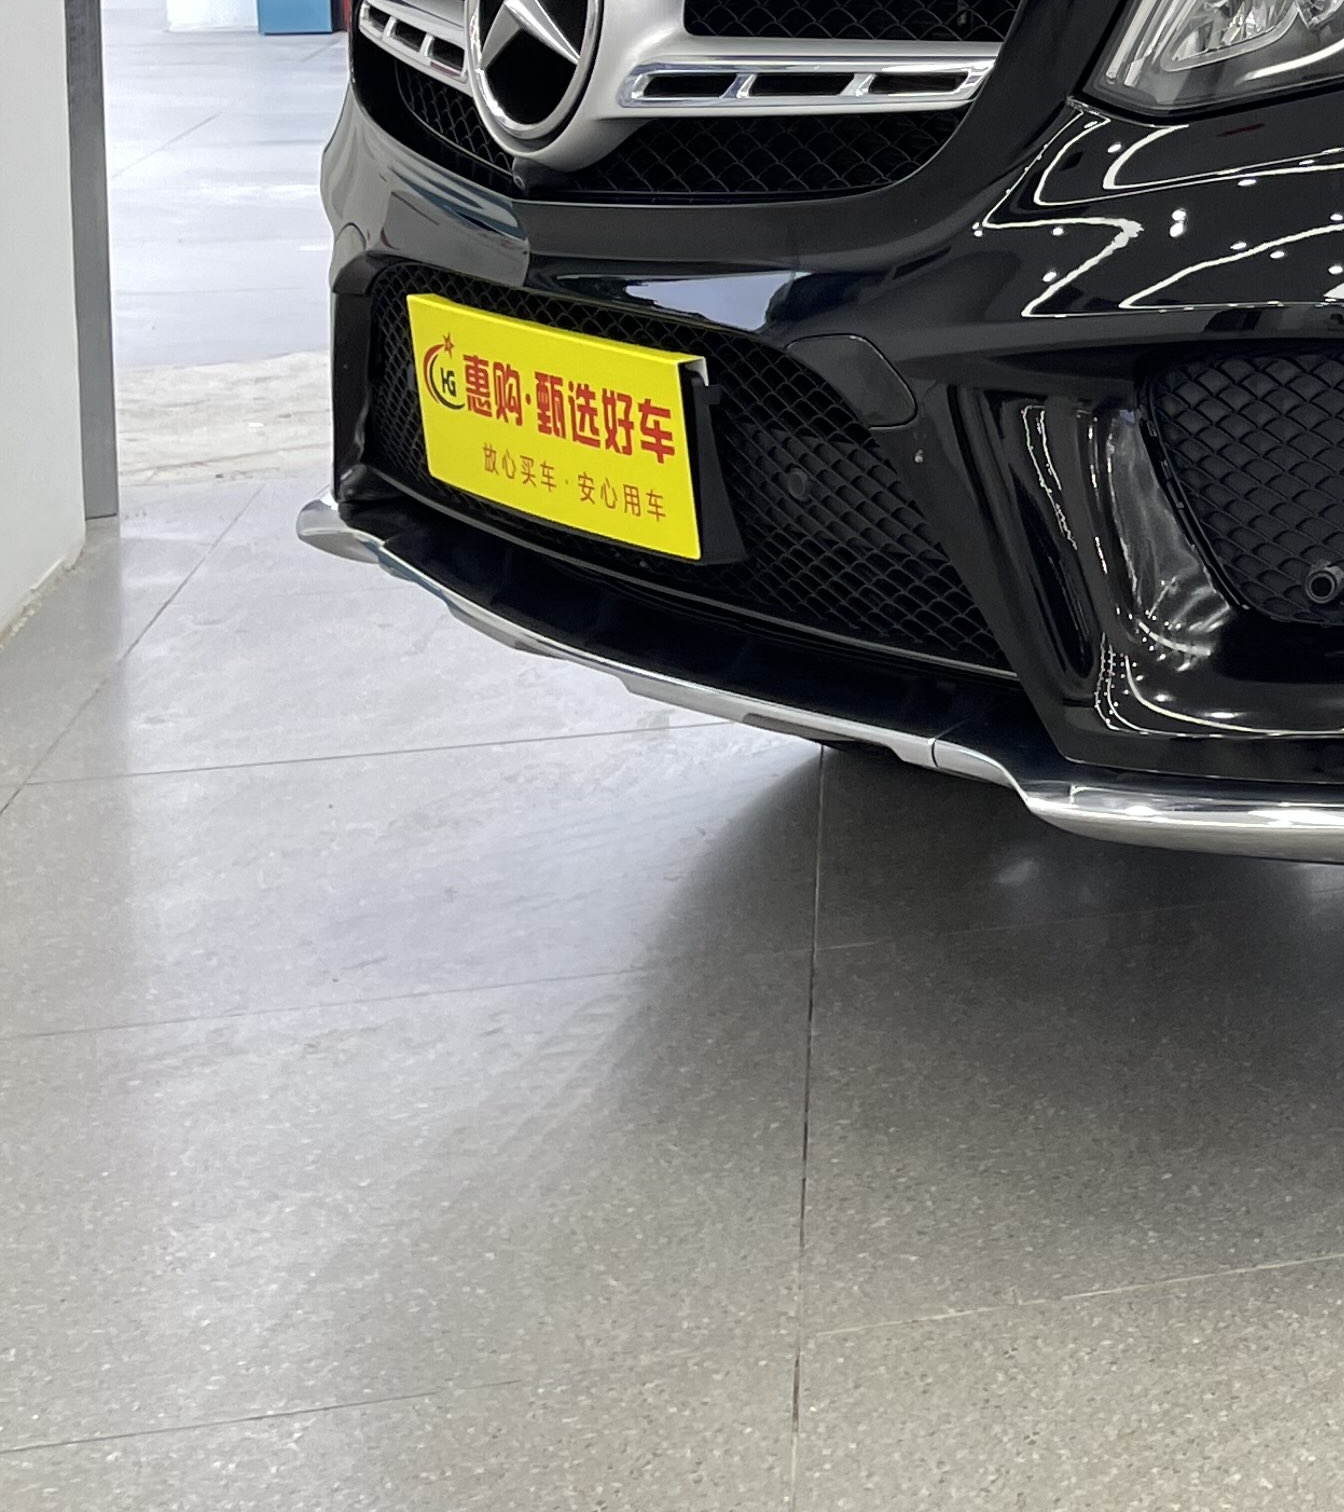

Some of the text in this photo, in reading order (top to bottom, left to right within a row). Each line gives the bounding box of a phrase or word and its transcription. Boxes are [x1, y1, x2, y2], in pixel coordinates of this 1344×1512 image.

[462, 354, 676, 465] 惠购·甄选好车
